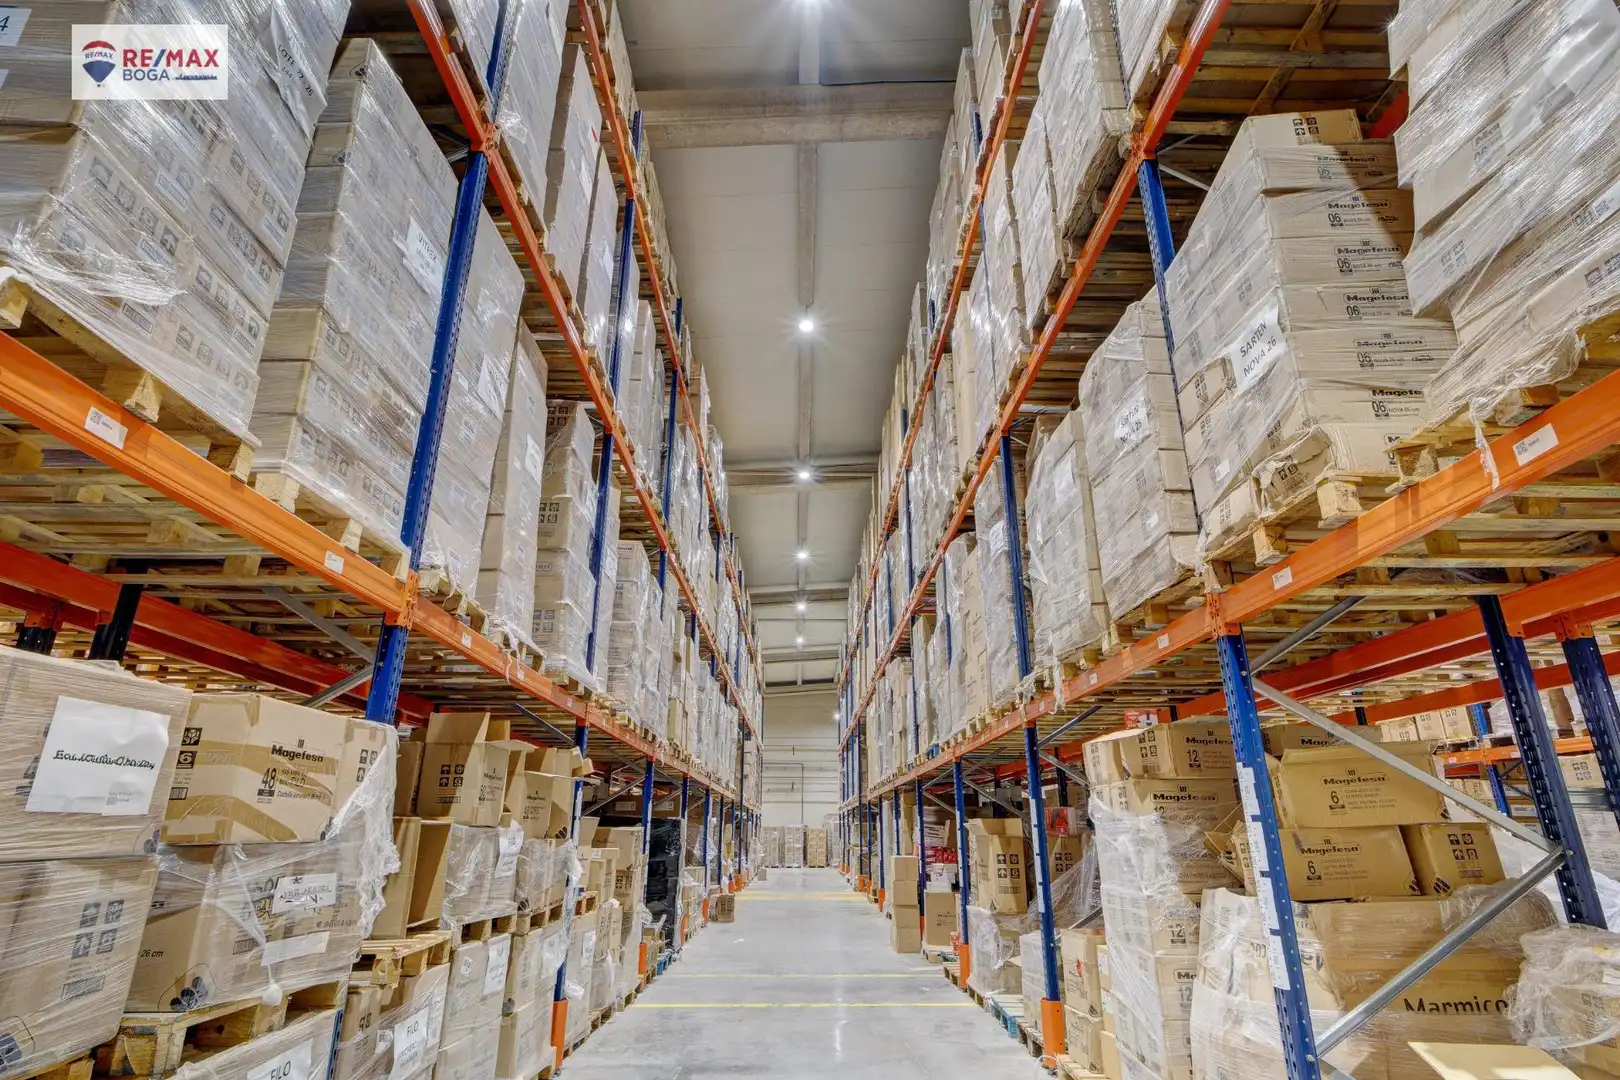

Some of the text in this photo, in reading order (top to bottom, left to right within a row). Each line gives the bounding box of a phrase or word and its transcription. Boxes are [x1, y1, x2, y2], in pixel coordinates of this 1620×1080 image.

[1327, 212, 1342, 223] 06
[1336, 245, 1400, 256] Magefesa
[1336, 257, 1351, 269] 06
[1346, 293, 1409, 302] Magefesa
[1346, 305, 1360, 317] 06
[1240, 320, 1267, 358] SARTEN
[1243, 335, 1277, 378] NOVA 26
[1371, 400, 1387, 413] 06
[271, 744, 324, 763] Magefesa
[1187, 749, 1200, 763] 12
[262, 767, 277, 790] 48
[1323, 775, 1386, 786] Magefesa
[1330, 790, 1340, 805] 6
[1301, 845, 1359, 856] Magefesa
[1307, 860, 1316, 875] 6
[1168, 923, 1184, 938] 12
[140, 948, 165, 958] 26 cm
[1178, 986, 1192, 1002] 12
